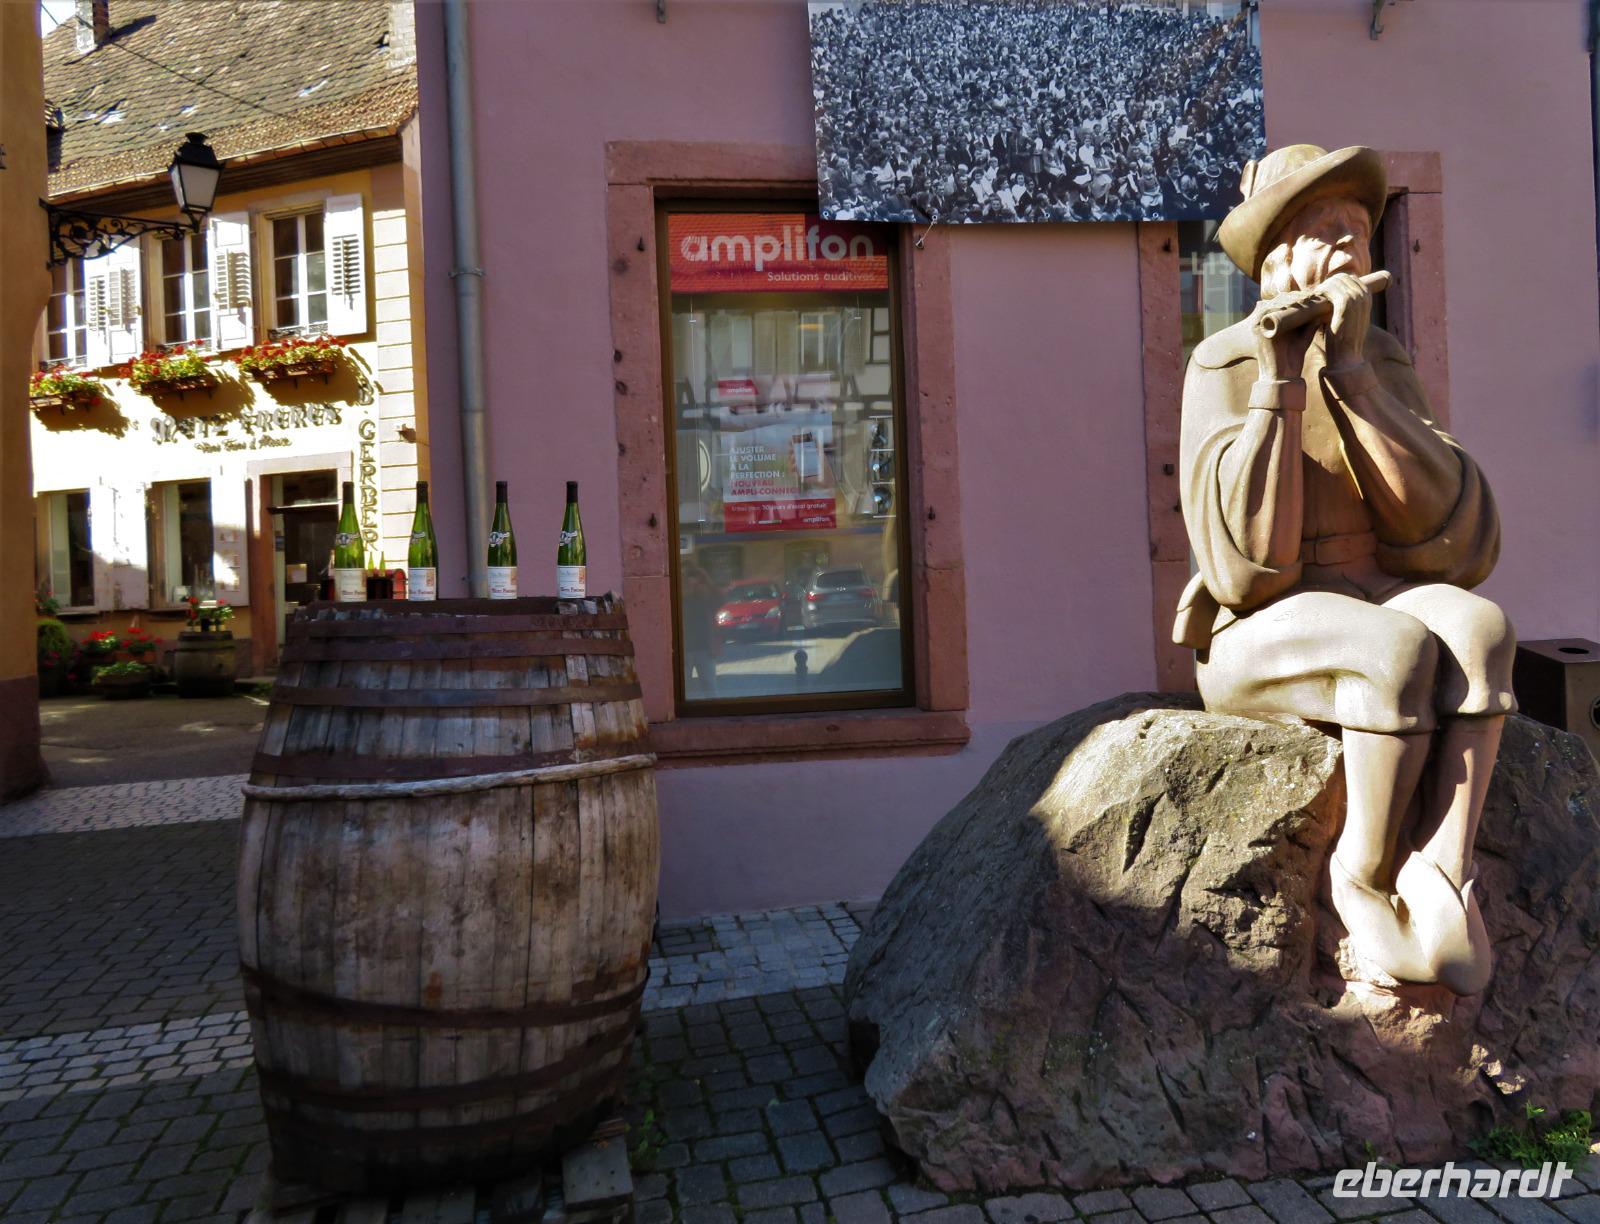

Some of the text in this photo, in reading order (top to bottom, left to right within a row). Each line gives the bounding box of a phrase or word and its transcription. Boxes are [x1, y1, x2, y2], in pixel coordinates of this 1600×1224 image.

[681, 224, 874, 272] amplifon
[767, 271, 819, 282] Solutions
[740, 453, 777, 462] VOLUME
